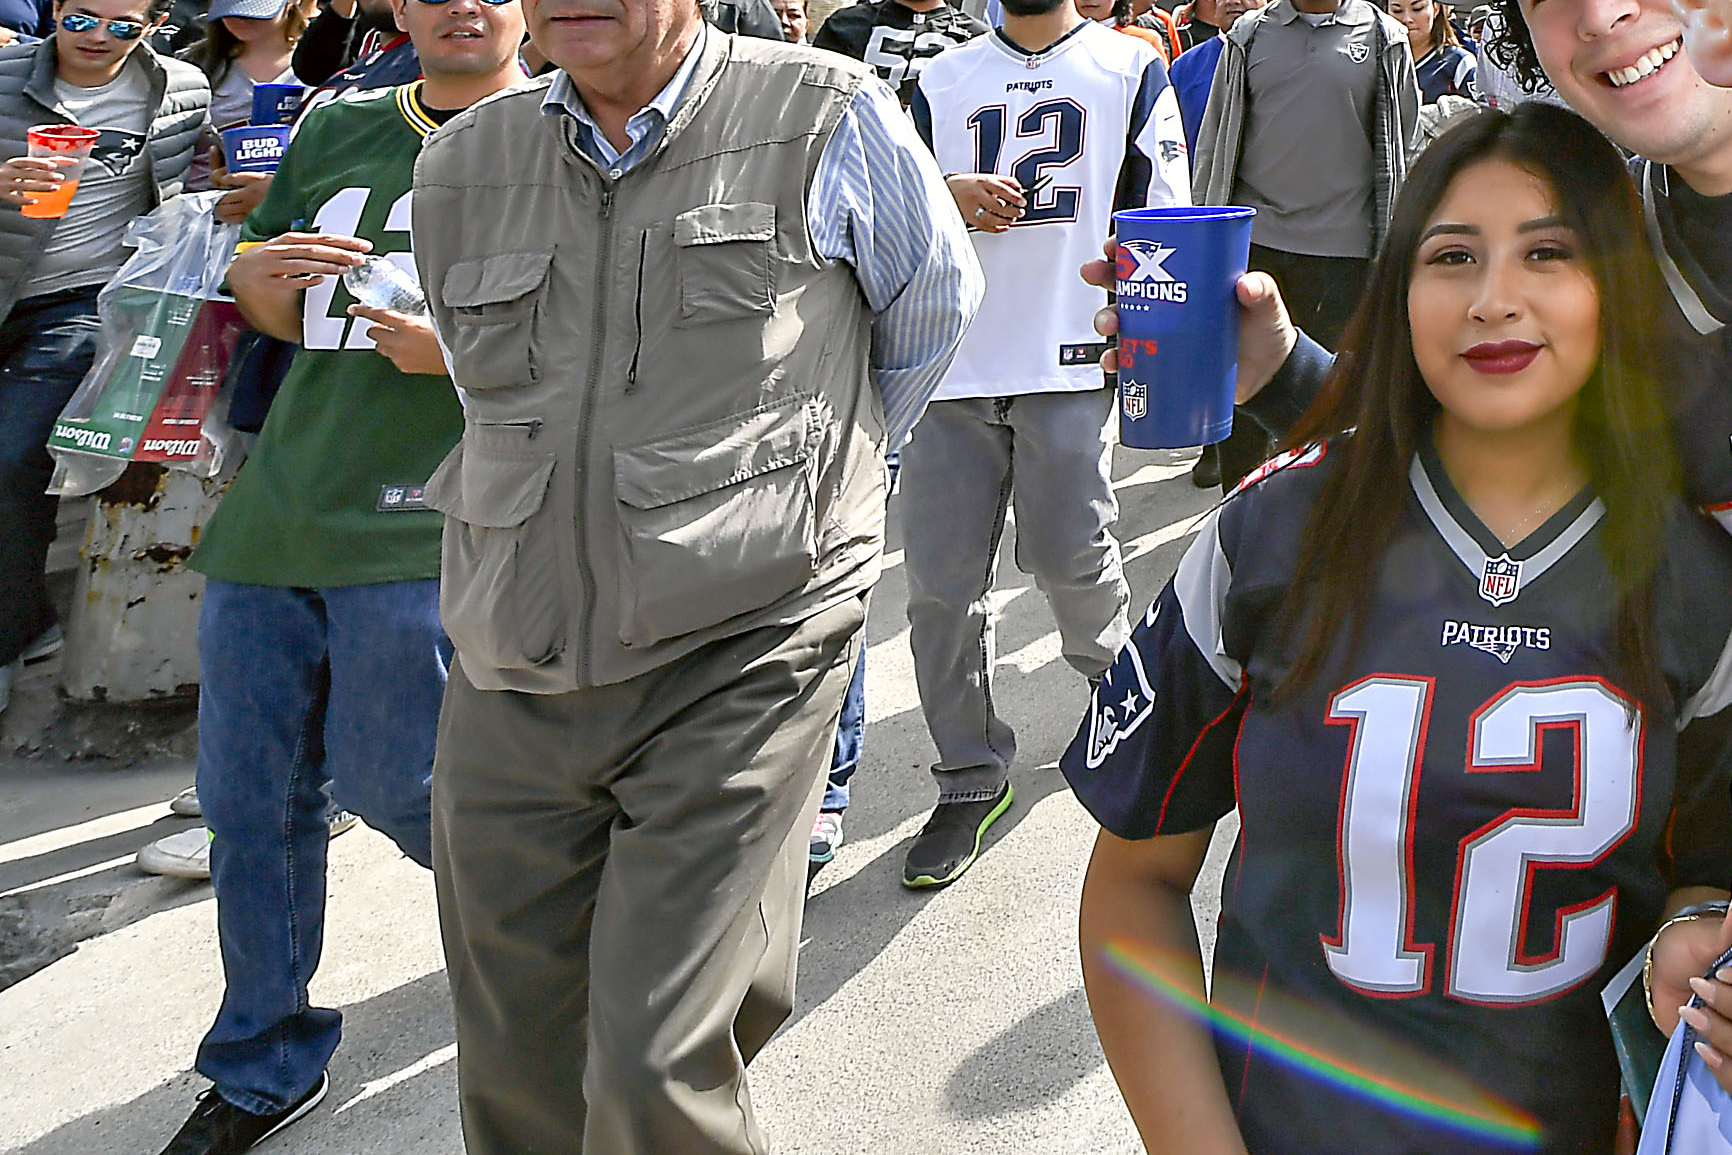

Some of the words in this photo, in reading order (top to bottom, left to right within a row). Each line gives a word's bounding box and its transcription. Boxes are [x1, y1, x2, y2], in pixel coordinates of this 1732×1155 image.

[1006, 79, 1053, 93] PATRIOTS
[236, 146, 284, 160] LIGHT
[242, 138, 279, 149] BUD
[967, 97, 1087, 228] 12
[1125, 398, 1143, 415] NFL
[55, 424, 111, 450] Wilson
[144, 439, 200, 456] Wilson
[1486, 575, 1512, 596] NFL
[1441, 620, 1550, 651] PATRIOTS
[1319, 672, 1647, 1009] 12
